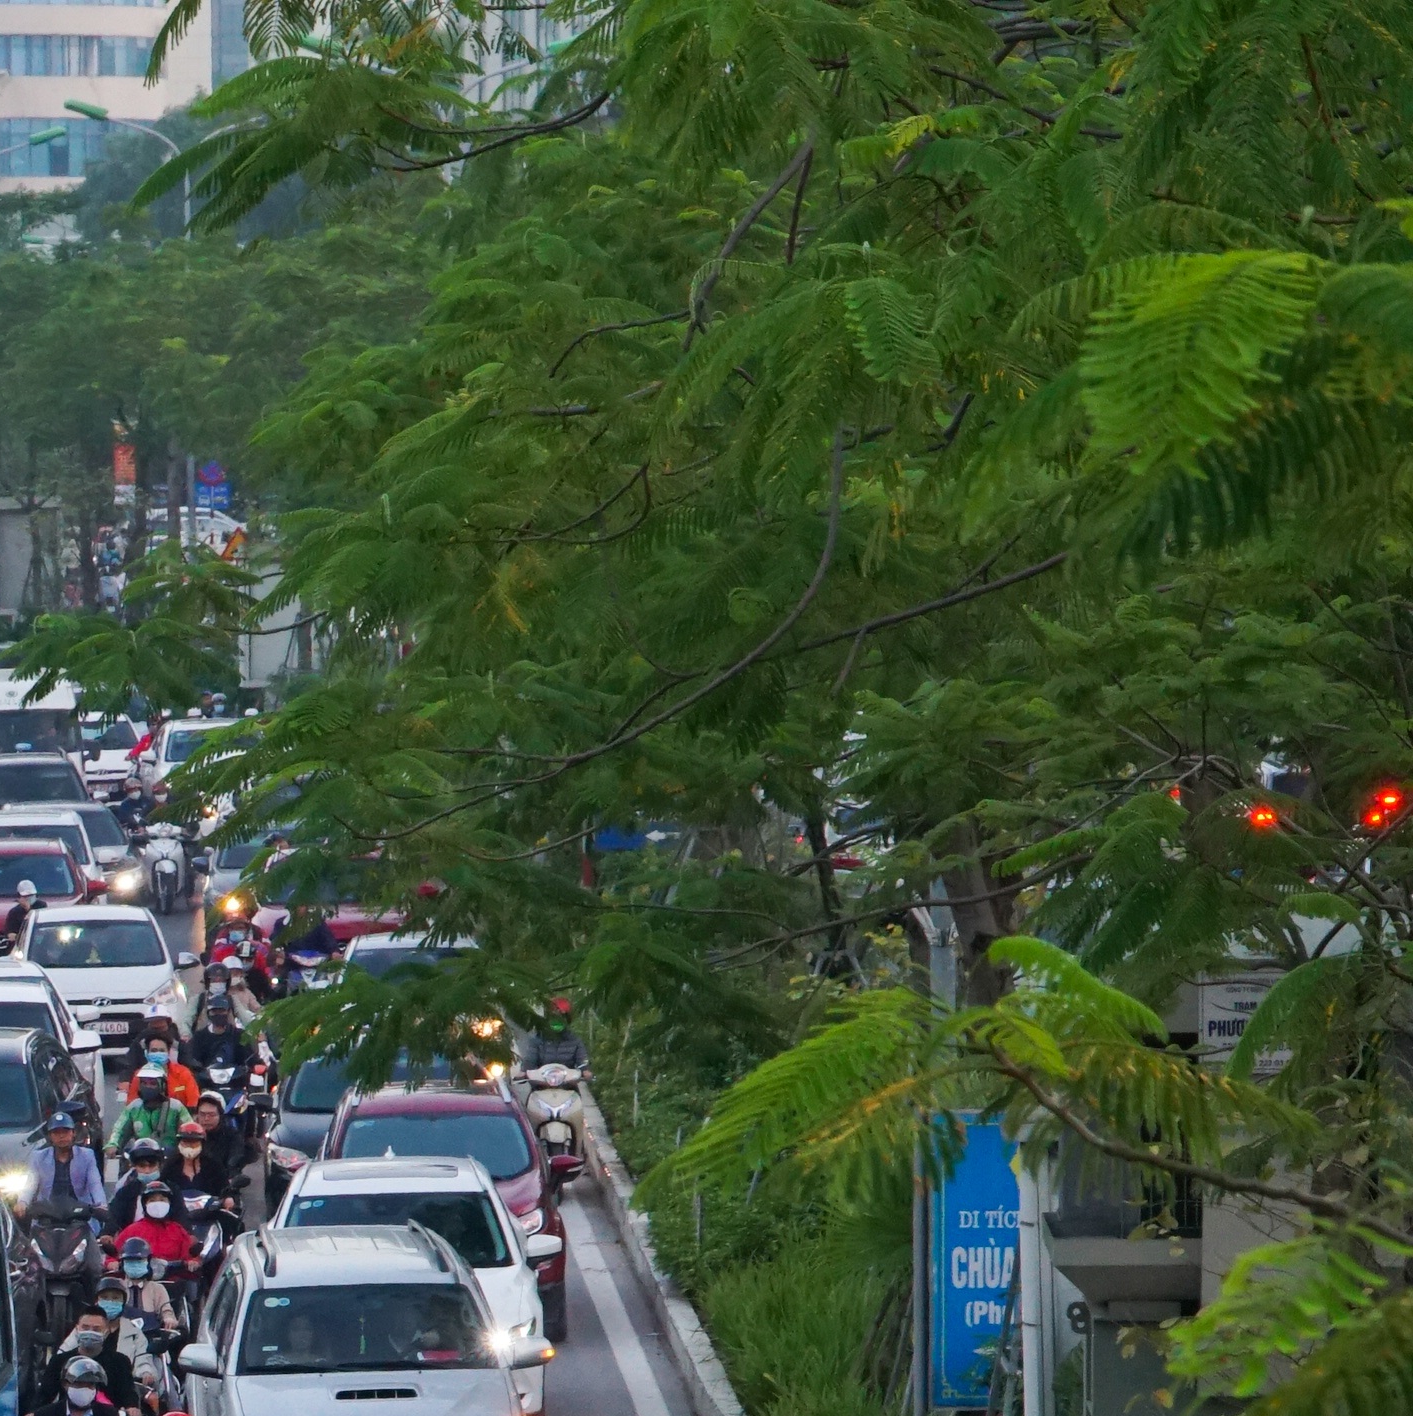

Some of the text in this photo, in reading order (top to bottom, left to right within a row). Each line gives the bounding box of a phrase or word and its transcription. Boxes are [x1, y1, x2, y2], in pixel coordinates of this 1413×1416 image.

[1208, 1018, 1246, 1037] PHƯƠ
[959, 1210, 979, 1229] DI
[952, 1238, 1015, 1289] CHÙA
